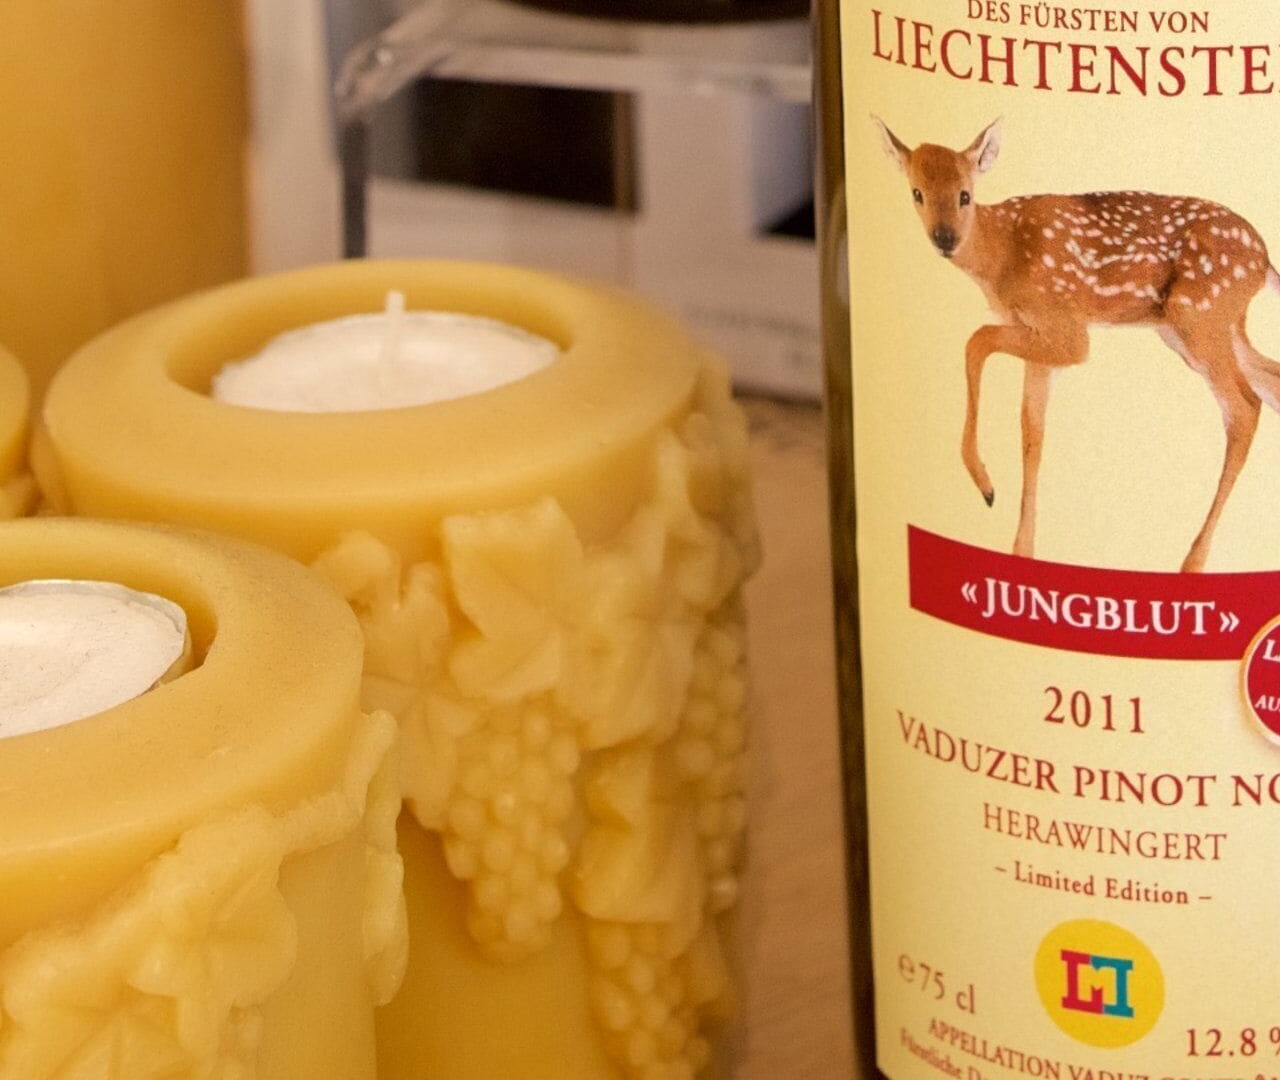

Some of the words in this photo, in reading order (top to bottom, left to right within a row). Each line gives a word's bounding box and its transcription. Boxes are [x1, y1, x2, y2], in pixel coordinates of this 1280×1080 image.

[1019, 2, 1139, 34] FÜRSTEN
[1148, 10, 1210, 33] VON
[1043, 686, 1146, 735] 2011
[896, 709, 1061, 795] VADUZER
[1073, 765, 1217, 807] PINOT
[983, 803, 1228, 861] HERAWINGERT
[1014, 861, 1096, 897] Limited
[1104, 877, 1190, 906] Edition
[956, 984, 975, 1014] cl
[928, 1017, 1061, 1080] APPELLATION
[1187, 1027, 1257, 1057] 12.8
